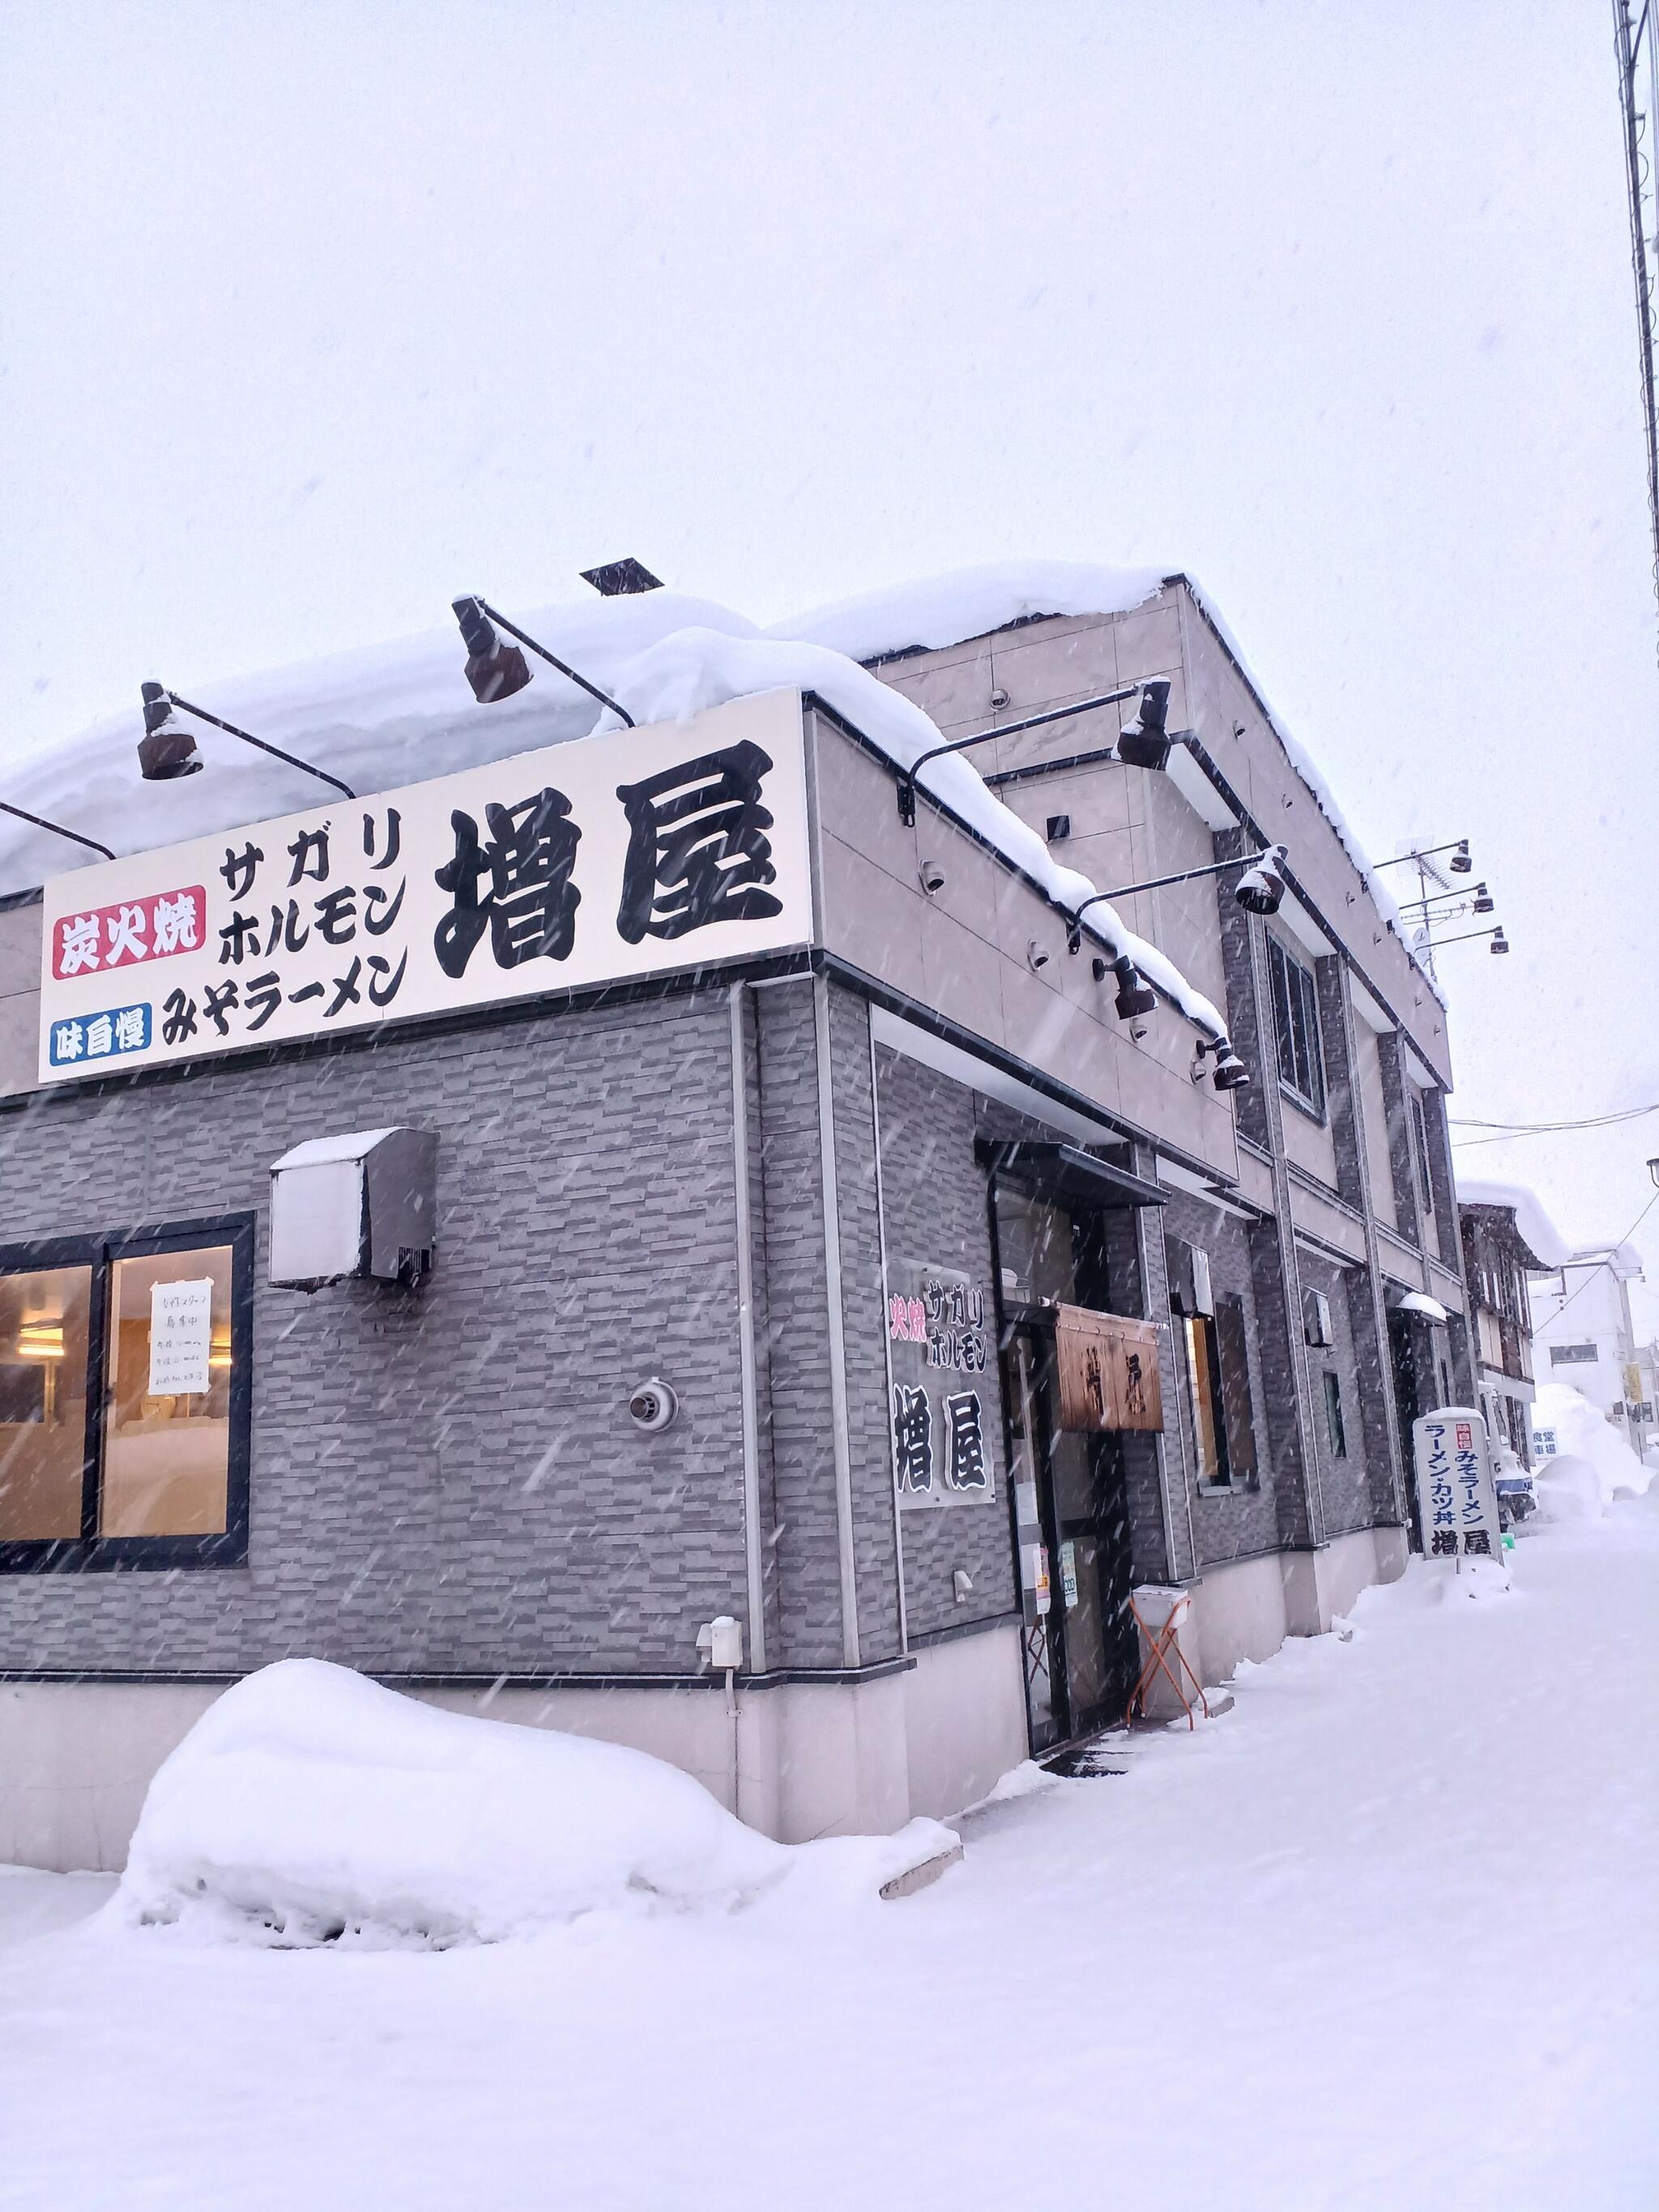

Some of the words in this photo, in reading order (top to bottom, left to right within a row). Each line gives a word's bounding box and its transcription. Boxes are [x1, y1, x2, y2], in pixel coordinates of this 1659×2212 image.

[220, 808, 402, 902] サガリ
[433, 739, 783, 979] 増屋
[61, 893, 199, 974] 炭火焼
[218, 876, 407, 965] ホルモン
[56, 1009, 145, 1061] 味自慢
[161, 945, 408, 1046] みそラーメン
[927, 1280, 984, 1332] サガリ
[927, 1328, 987, 1373] ホルモン
[893, 1383, 987, 1494] 増屋
[1455, 1450, 1484, 1525] みそラーメン
[1431, 1529, 1492, 1556] 増屋
